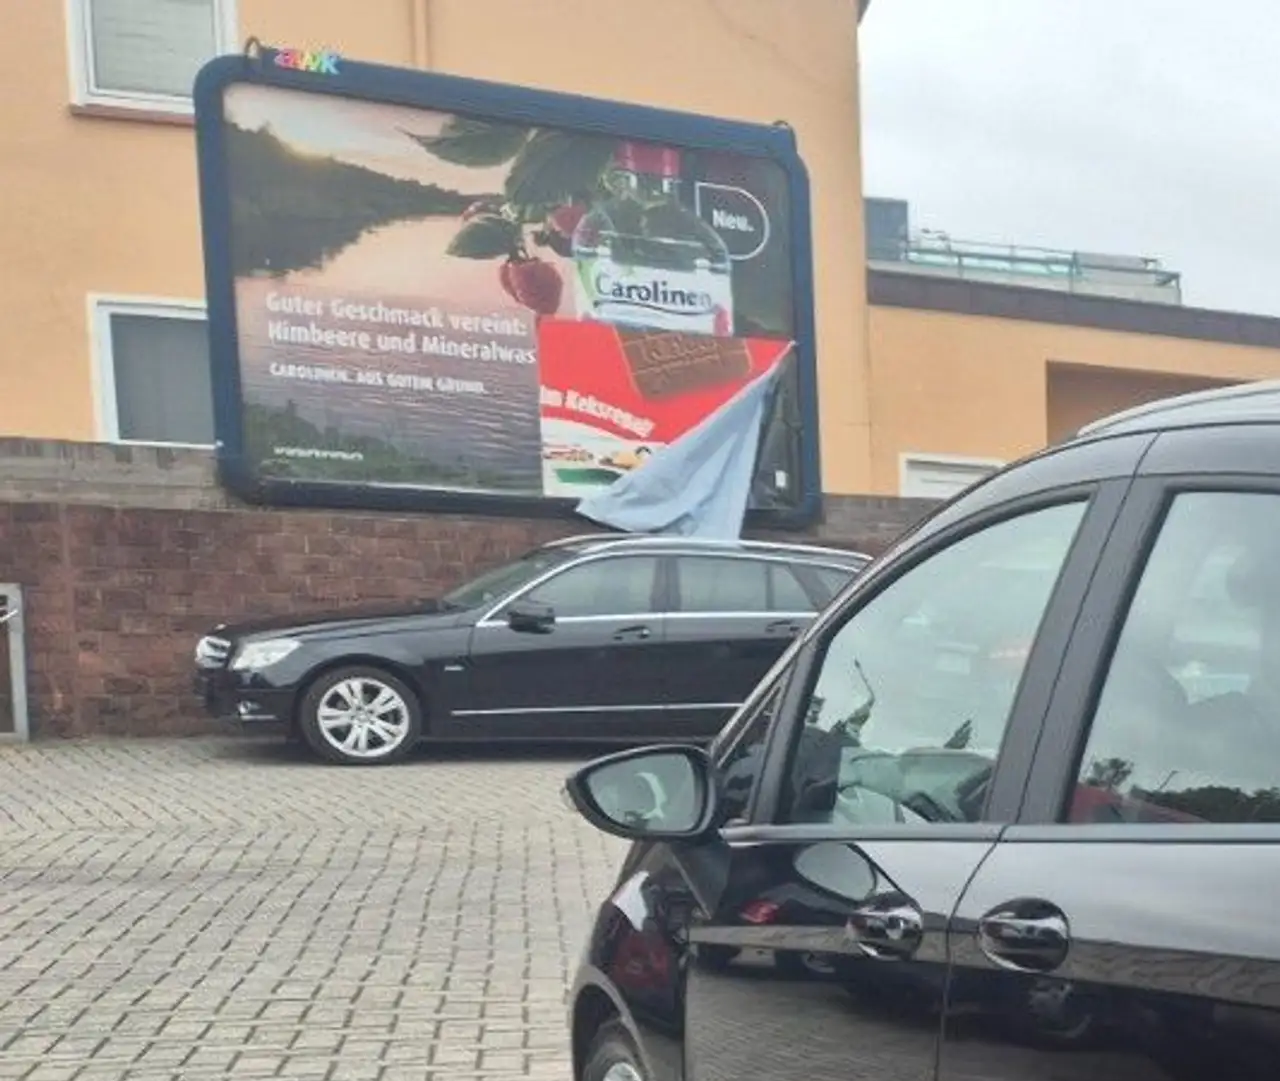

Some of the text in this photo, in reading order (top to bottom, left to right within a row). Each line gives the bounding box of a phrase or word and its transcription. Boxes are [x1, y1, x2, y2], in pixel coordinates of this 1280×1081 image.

[596, 273, 712, 306] Carolinen
[266, 292, 528, 336] Guter Geschmack vereint:
[268, 320, 371, 349] Himbeere
[377, 330, 416, 354] und
